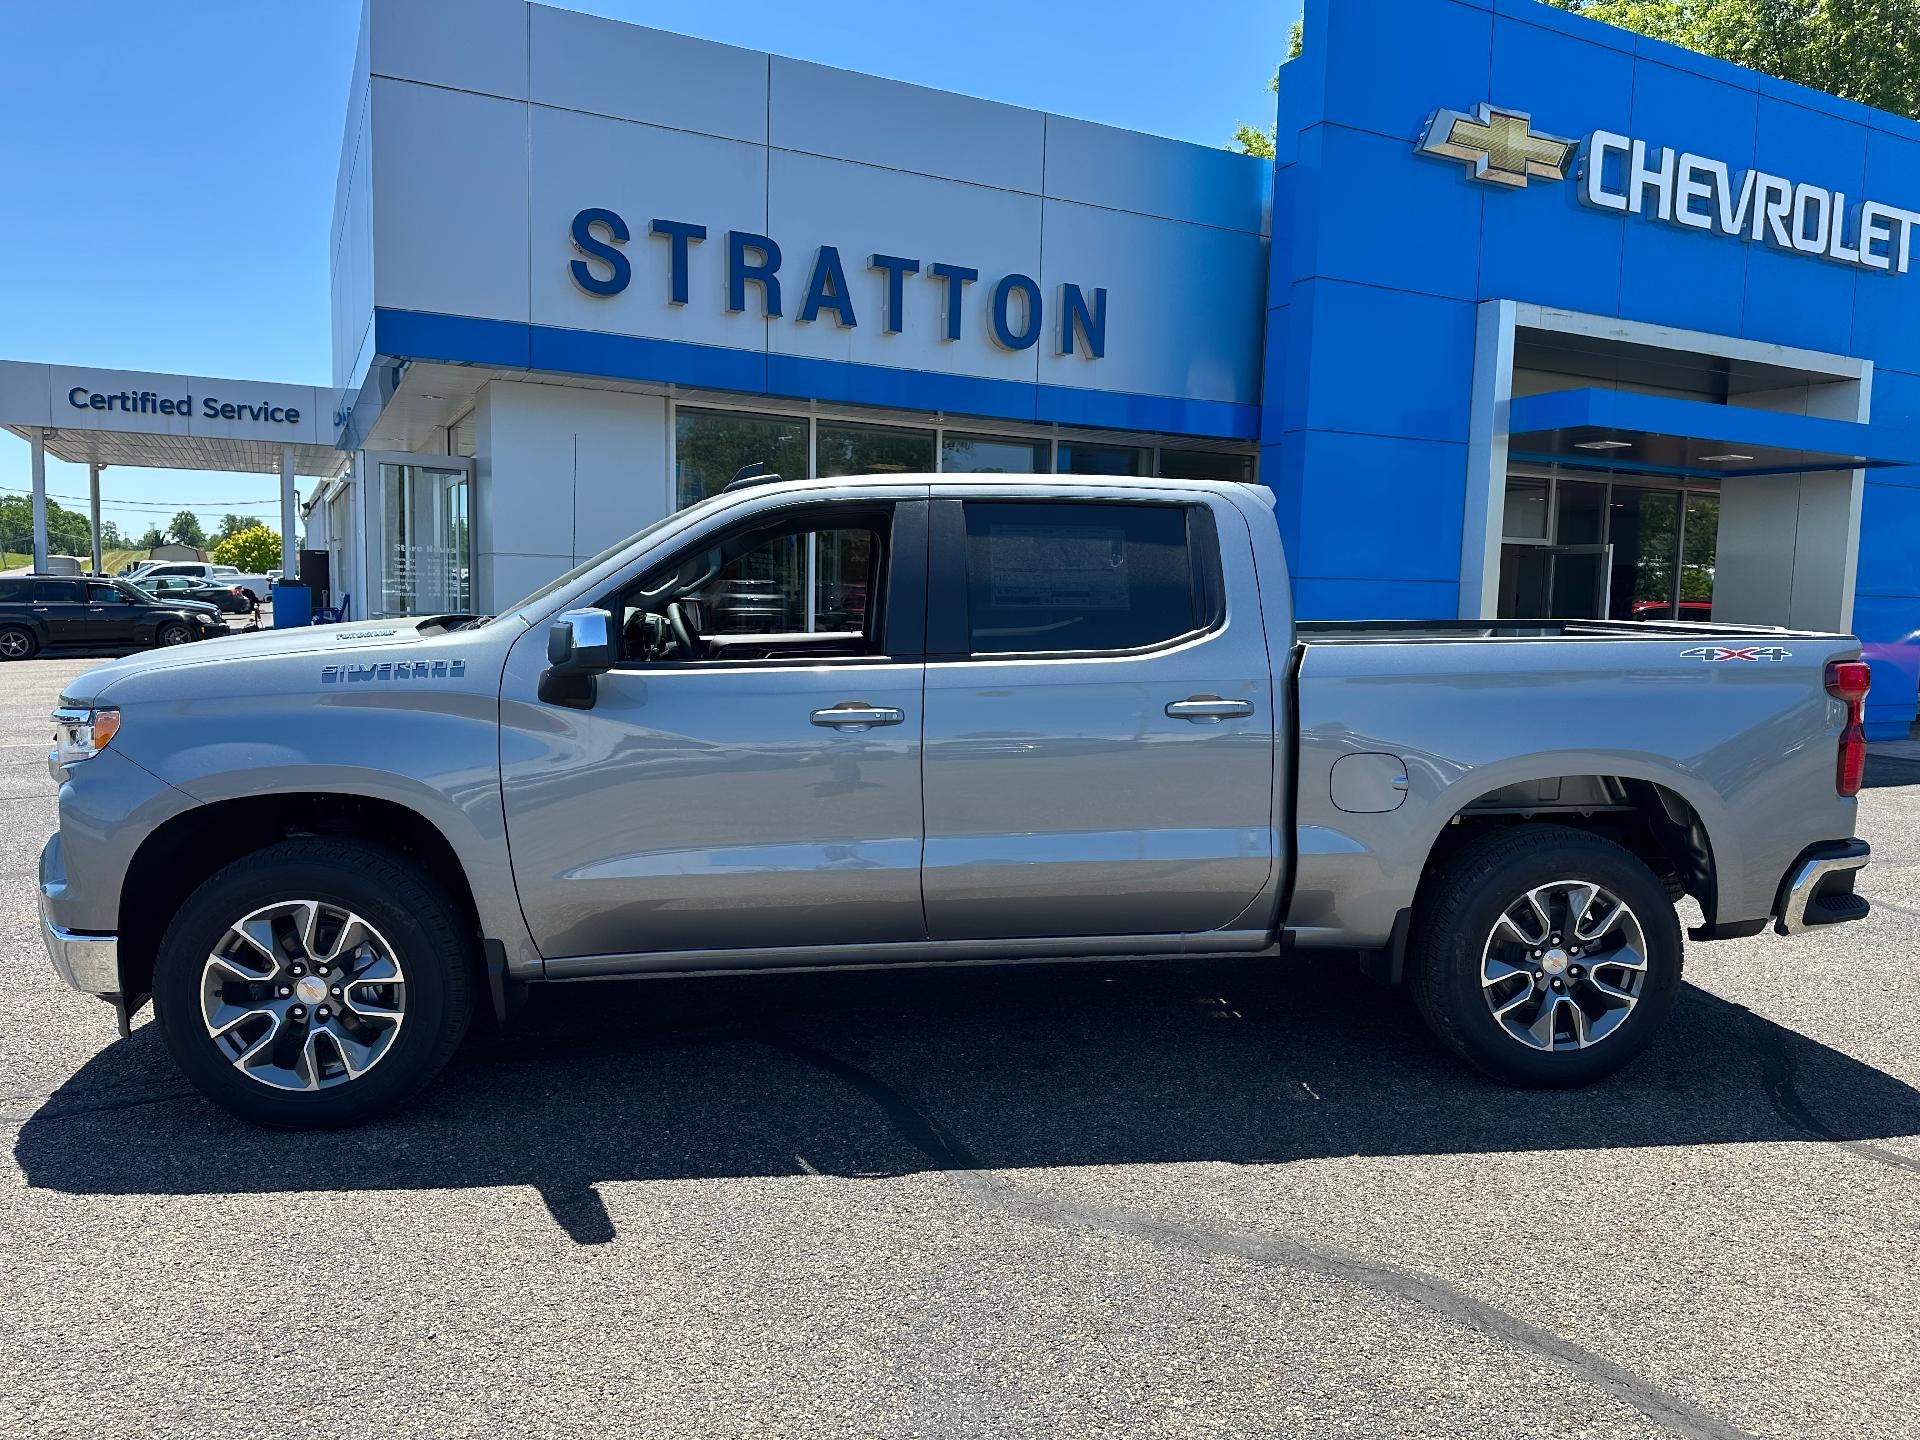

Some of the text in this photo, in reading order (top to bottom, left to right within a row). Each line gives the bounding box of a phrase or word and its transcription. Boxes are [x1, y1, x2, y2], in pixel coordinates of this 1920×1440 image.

[1581, 129, 1920, 273] CHEVROLET
[567, 207, 1107, 360] STRATTON
[68, 387, 192, 417] Certified
[203, 397, 300, 424] Service
[321, 658, 466, 680] SILVERADO
